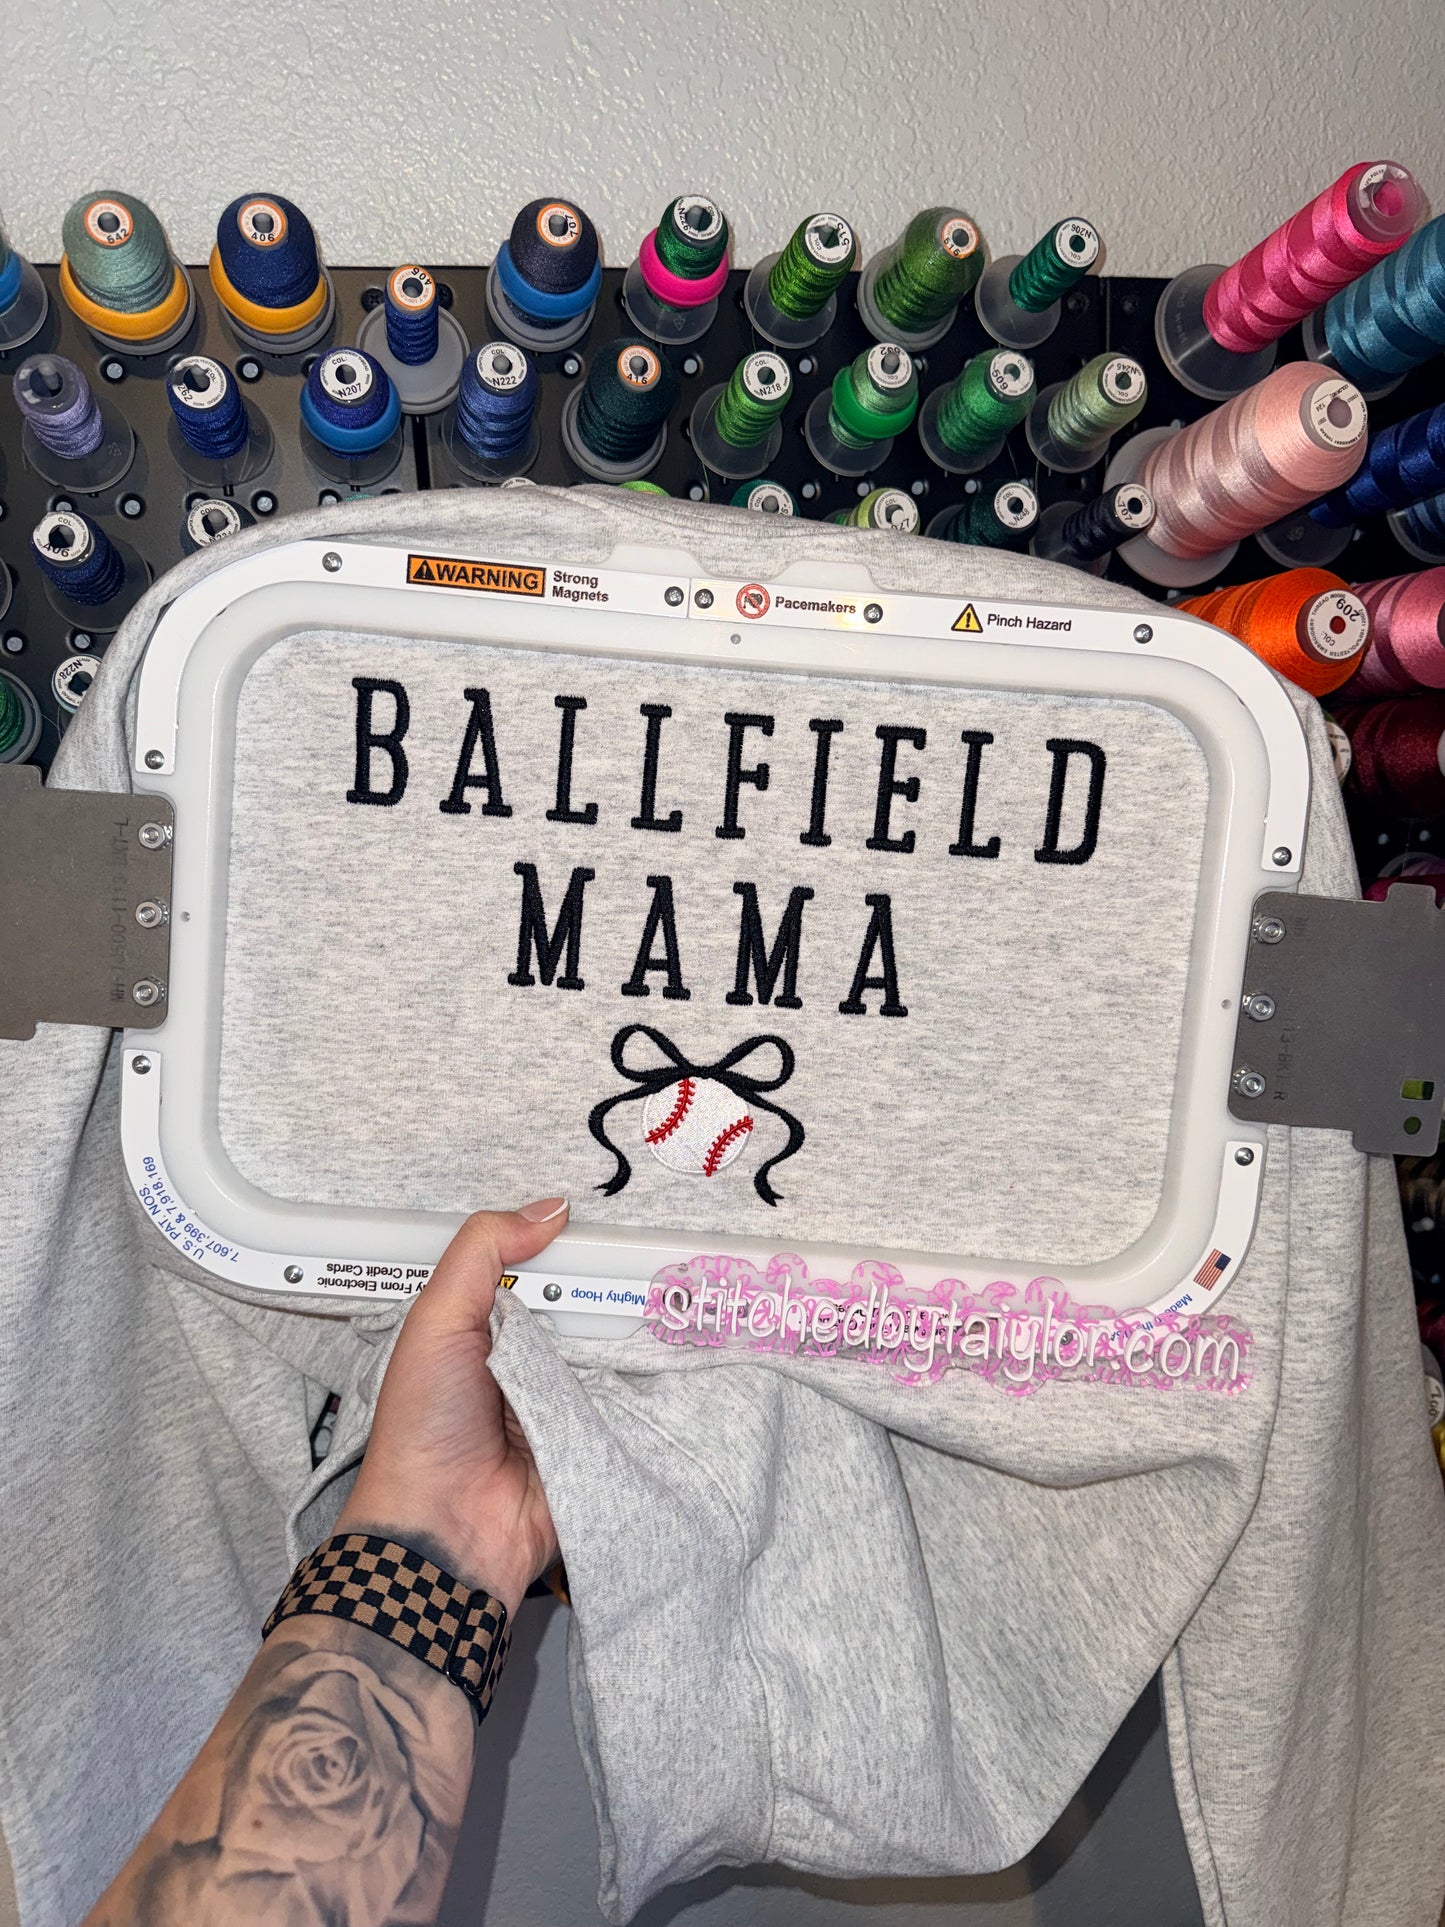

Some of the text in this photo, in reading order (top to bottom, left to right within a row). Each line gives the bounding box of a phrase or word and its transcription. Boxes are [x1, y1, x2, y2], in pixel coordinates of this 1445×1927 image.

[565, 214, 579, 238] 707
[1071, 223, 1092, 239] N206
[107, 228, 129, 244] 542
[251, 232, 275, 242] 406
[411, 267, 432, 286] 405
[493, 376, 517, 387] N222
[626, 373, 648, 385] 416
[992, 368, 1009, 391] 509
[178, 385, 193, 402] 262
[339, 383, 362, 398] N207
[759, 382, 782, 396] N218
[1117, 501, 1133, 522] 707
[42, 543, 70, 558] 406
[436, 563, 539, 590] WARNING
[553, 570, 599, 588] Strong
[552, 585, 609, 602] Magnets
[775, 596, 856, 614] Pacemakers
[1336, 598, 1361, 622] 209
[987, 613, 1072, 632] Pinch Hazard
[59, 659, 83, 680] N228
[346, 677, 1106, 865] BALLFIELD
[507, 861, 909, 1018] MAMA
[143, 1156, 239, 1262] 7,607,399 & 7,918,169
[139, 1183, 204, 1260] U.S. PAT. NOS.
[326, 1263, 429, 1279] and Credit Cards
[317, 1276, 377, 1291] Electronic
[381, 1281, 413, 1293] From
[571, 1288, 645, 1305] Mighty Hoop
[662, 1273, 1240, 1380] stitchedbytaiylor.com
